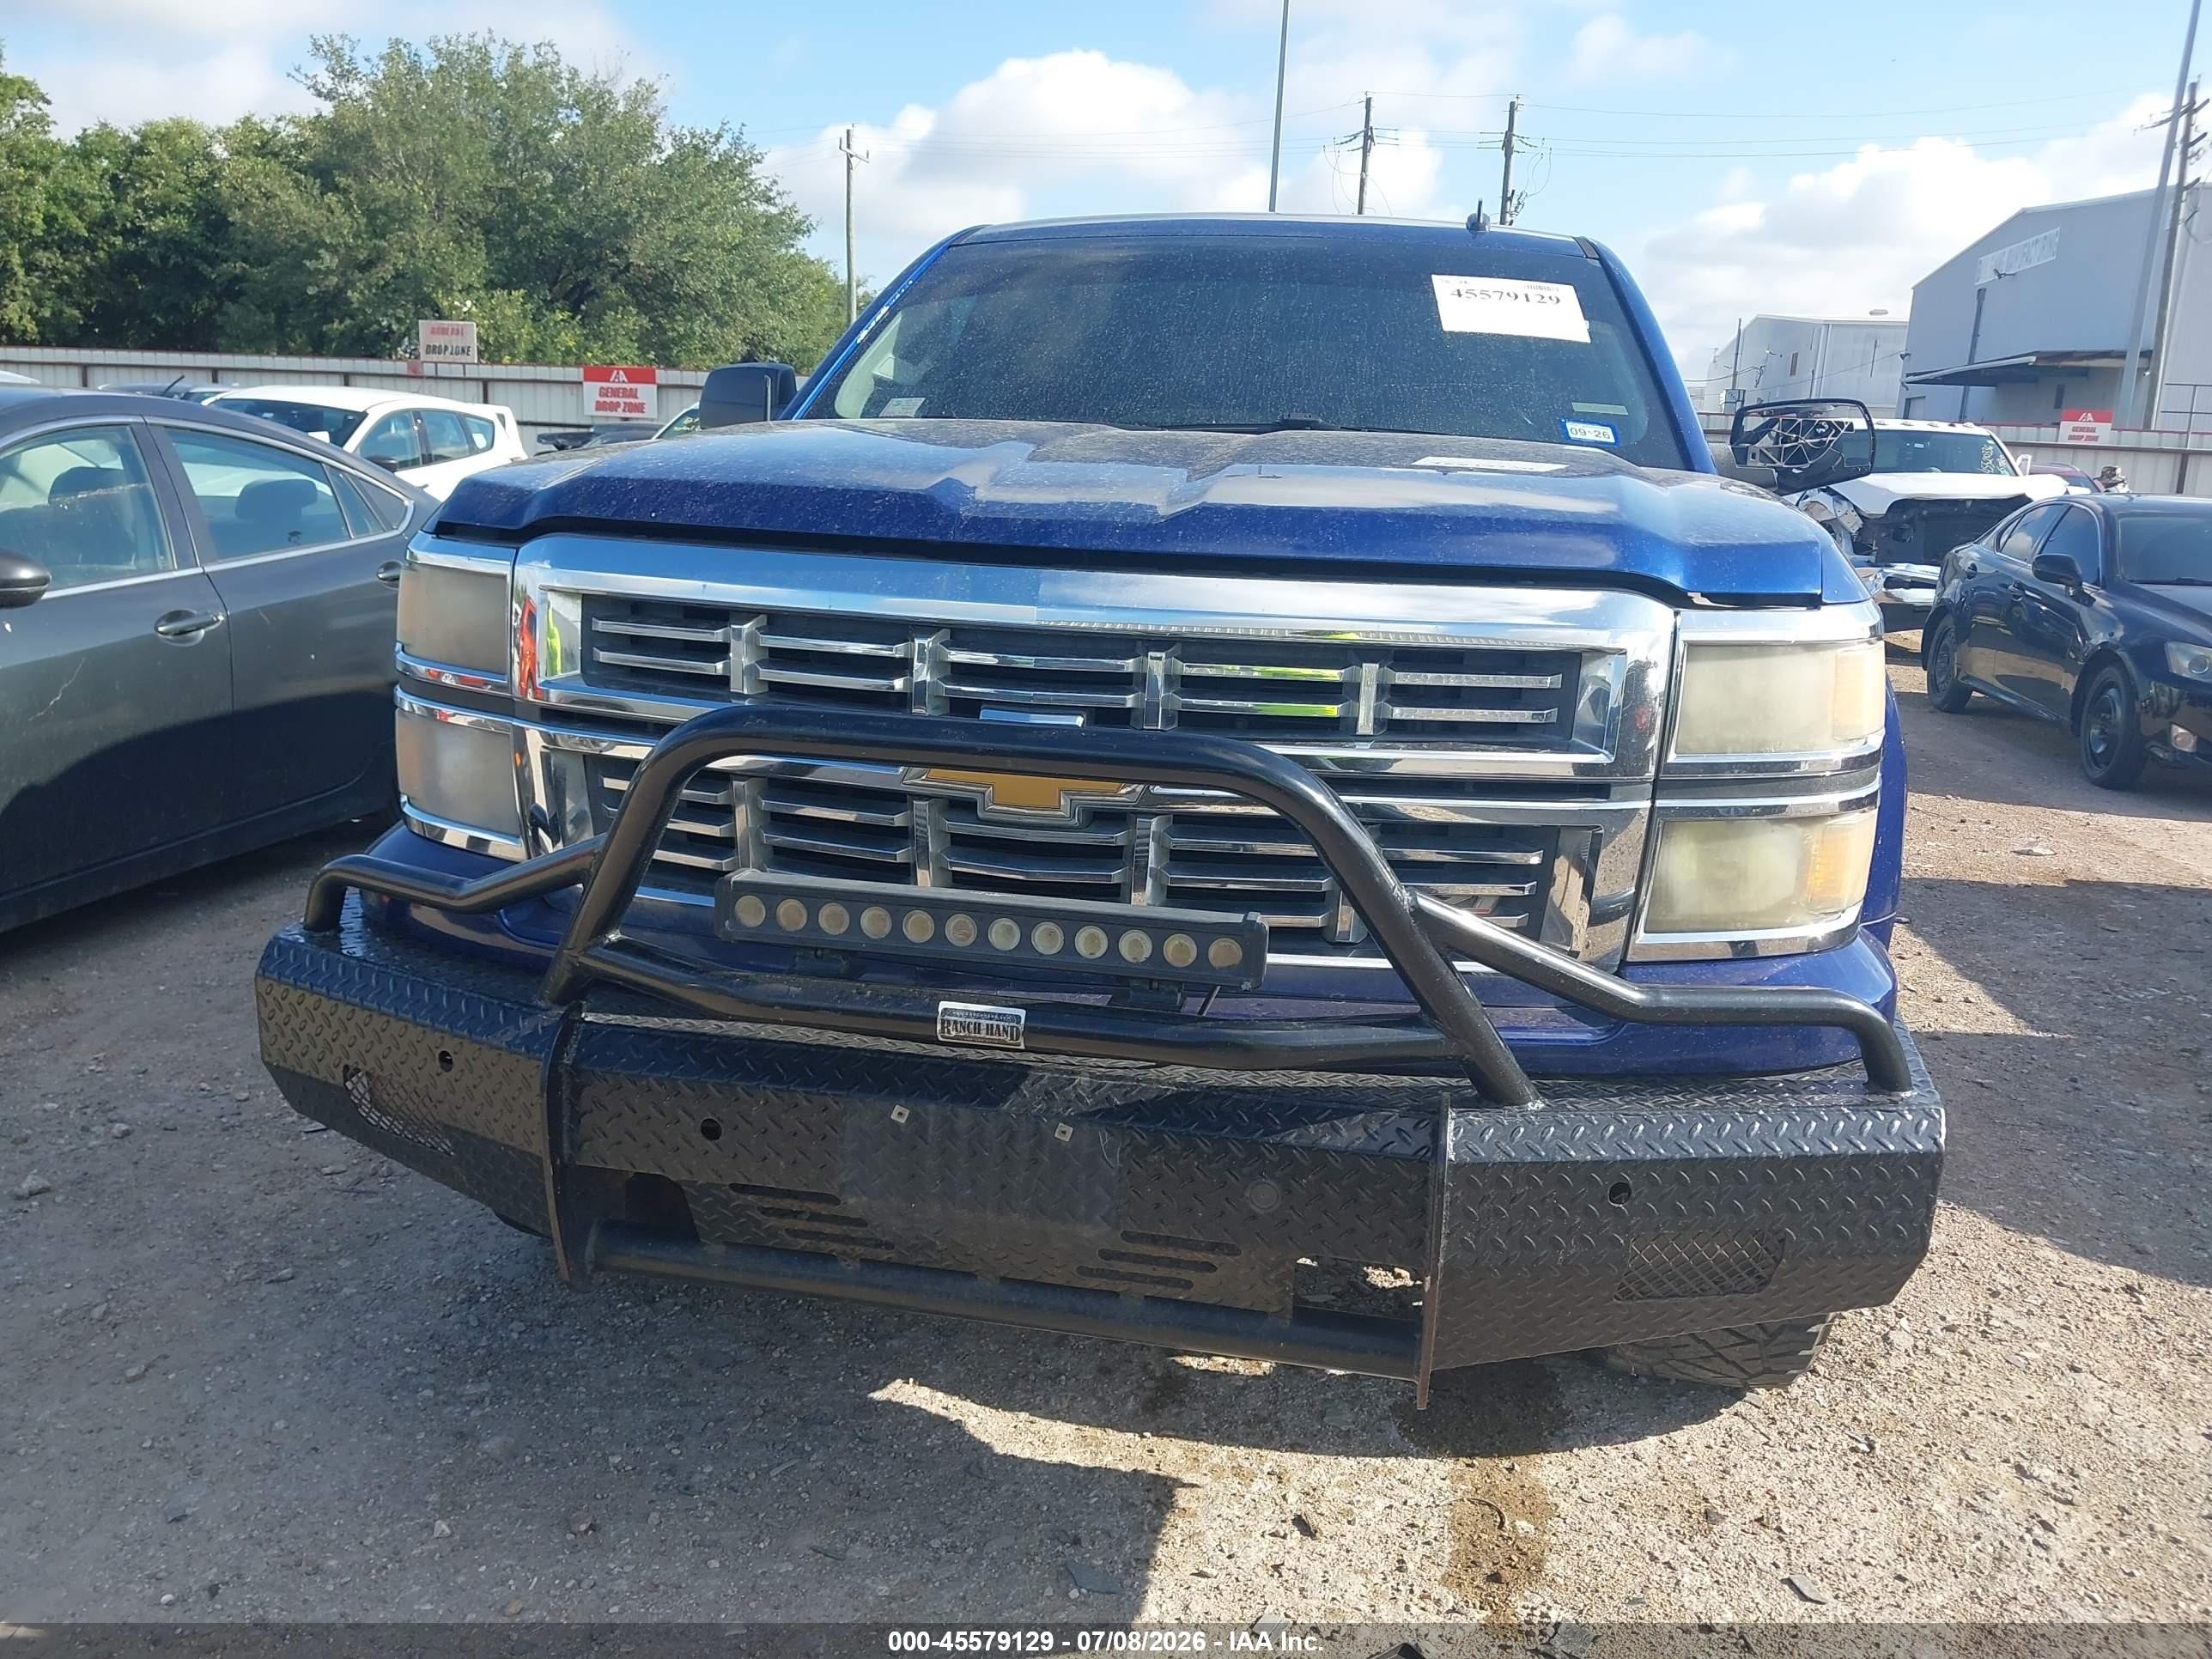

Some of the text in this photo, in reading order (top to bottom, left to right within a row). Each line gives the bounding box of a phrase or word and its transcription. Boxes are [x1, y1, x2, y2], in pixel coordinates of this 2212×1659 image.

[1450, 289, 1561, 305] 45579129
[426, 344, 449, 356] DROP
[599, 386, 639, 399] GENERAL
[595, 400, 646, 414] DROP ZONE
